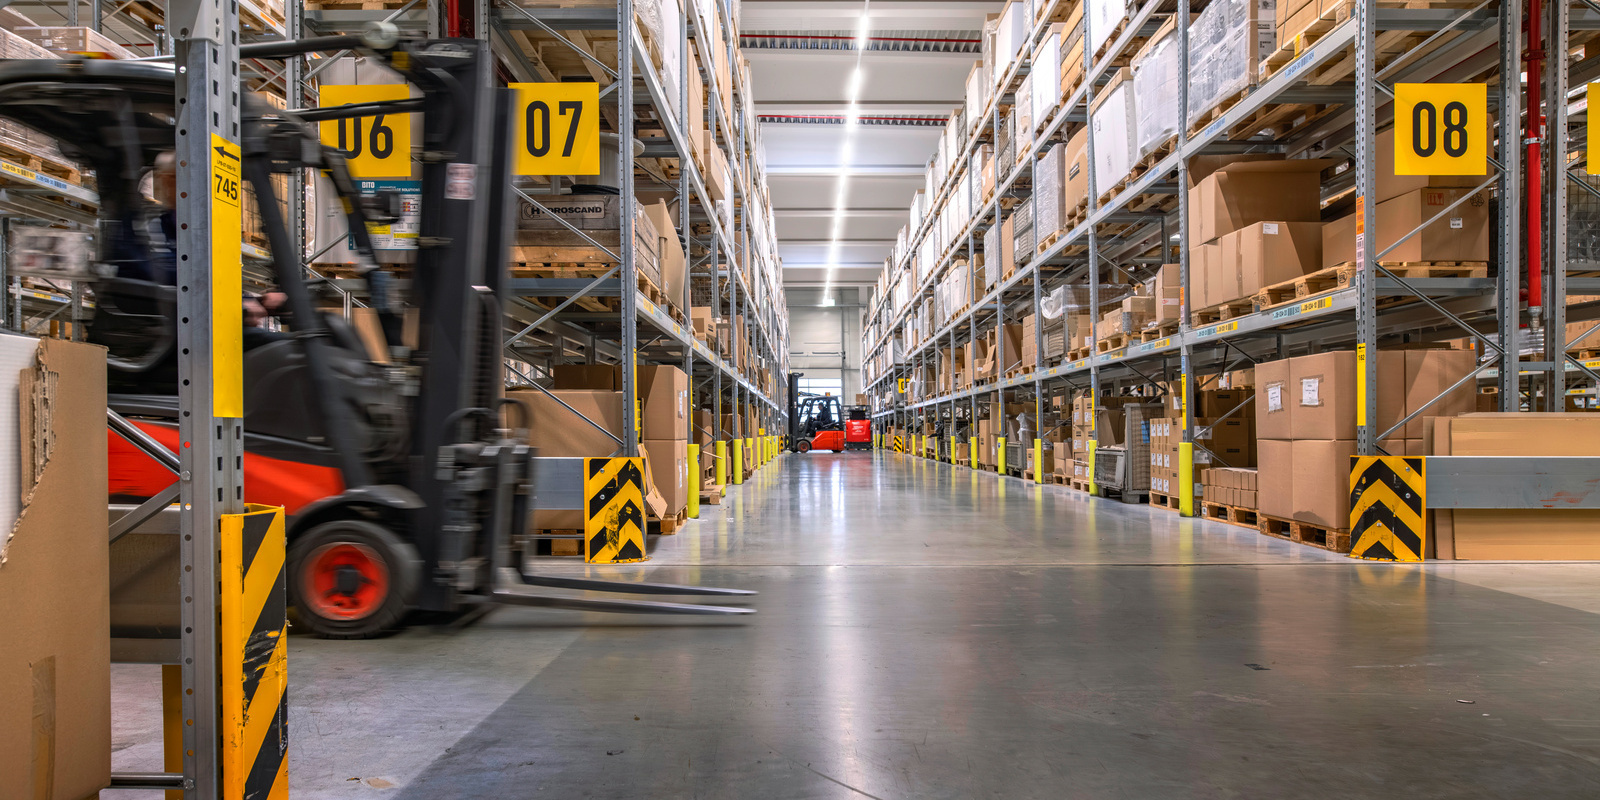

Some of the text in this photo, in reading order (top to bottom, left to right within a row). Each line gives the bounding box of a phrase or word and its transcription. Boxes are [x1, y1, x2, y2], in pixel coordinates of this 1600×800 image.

[338, 103, 393, 159] 06
[526, 101, 583, 158] 07
[1413, 101, 1468, 158] 08
[215, 173, 238, 201] 745
[362, 181, 375, 189] BITO
